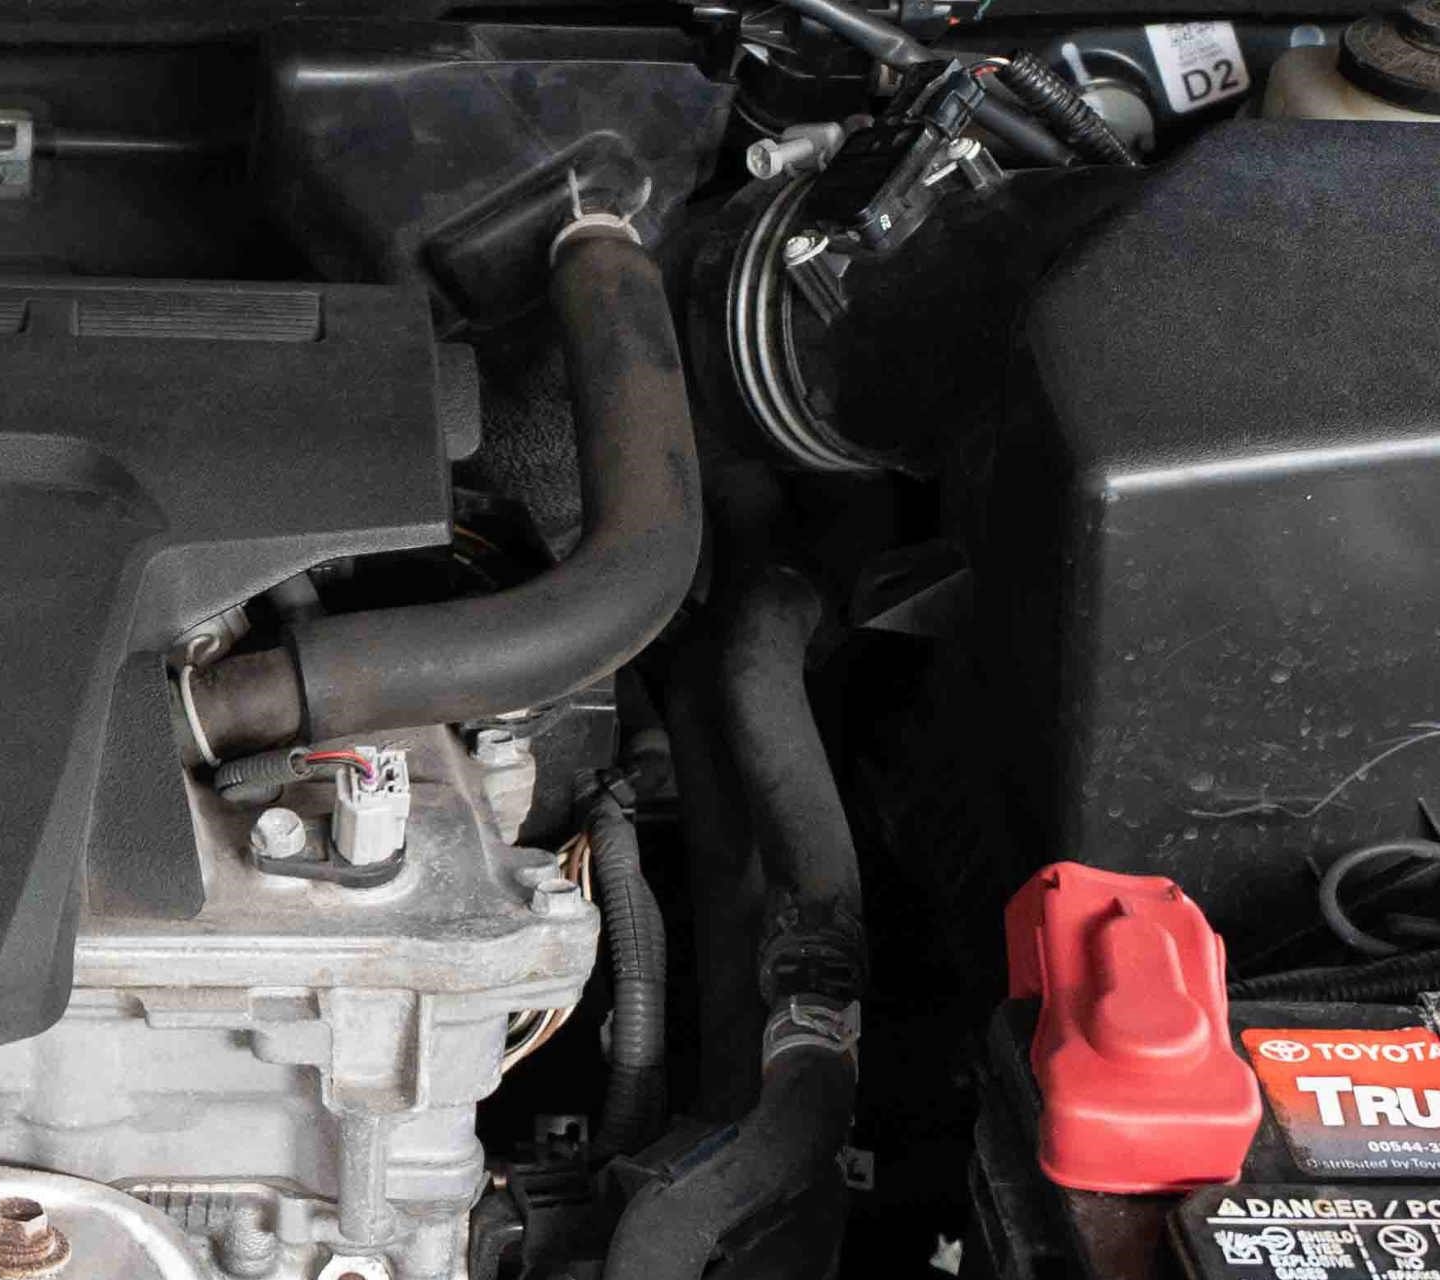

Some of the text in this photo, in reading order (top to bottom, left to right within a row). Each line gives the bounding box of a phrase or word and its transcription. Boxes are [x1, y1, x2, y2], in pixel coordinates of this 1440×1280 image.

[1182, 58, 1240, 102] D2
[1247, 1199, 1377, 1218] DANGER
[1383, 1201, 1398, 1218] /
[1297, 1230, 1354, 1244] SHIELD
[1302, 1242, 1344, 1255] EYES
[1269, 1254, 1355, 1268] EXPLOSIVE
[1395, 1258, 1425, 1270] NO
[1275, 1268, 1328, 1280] GASES
